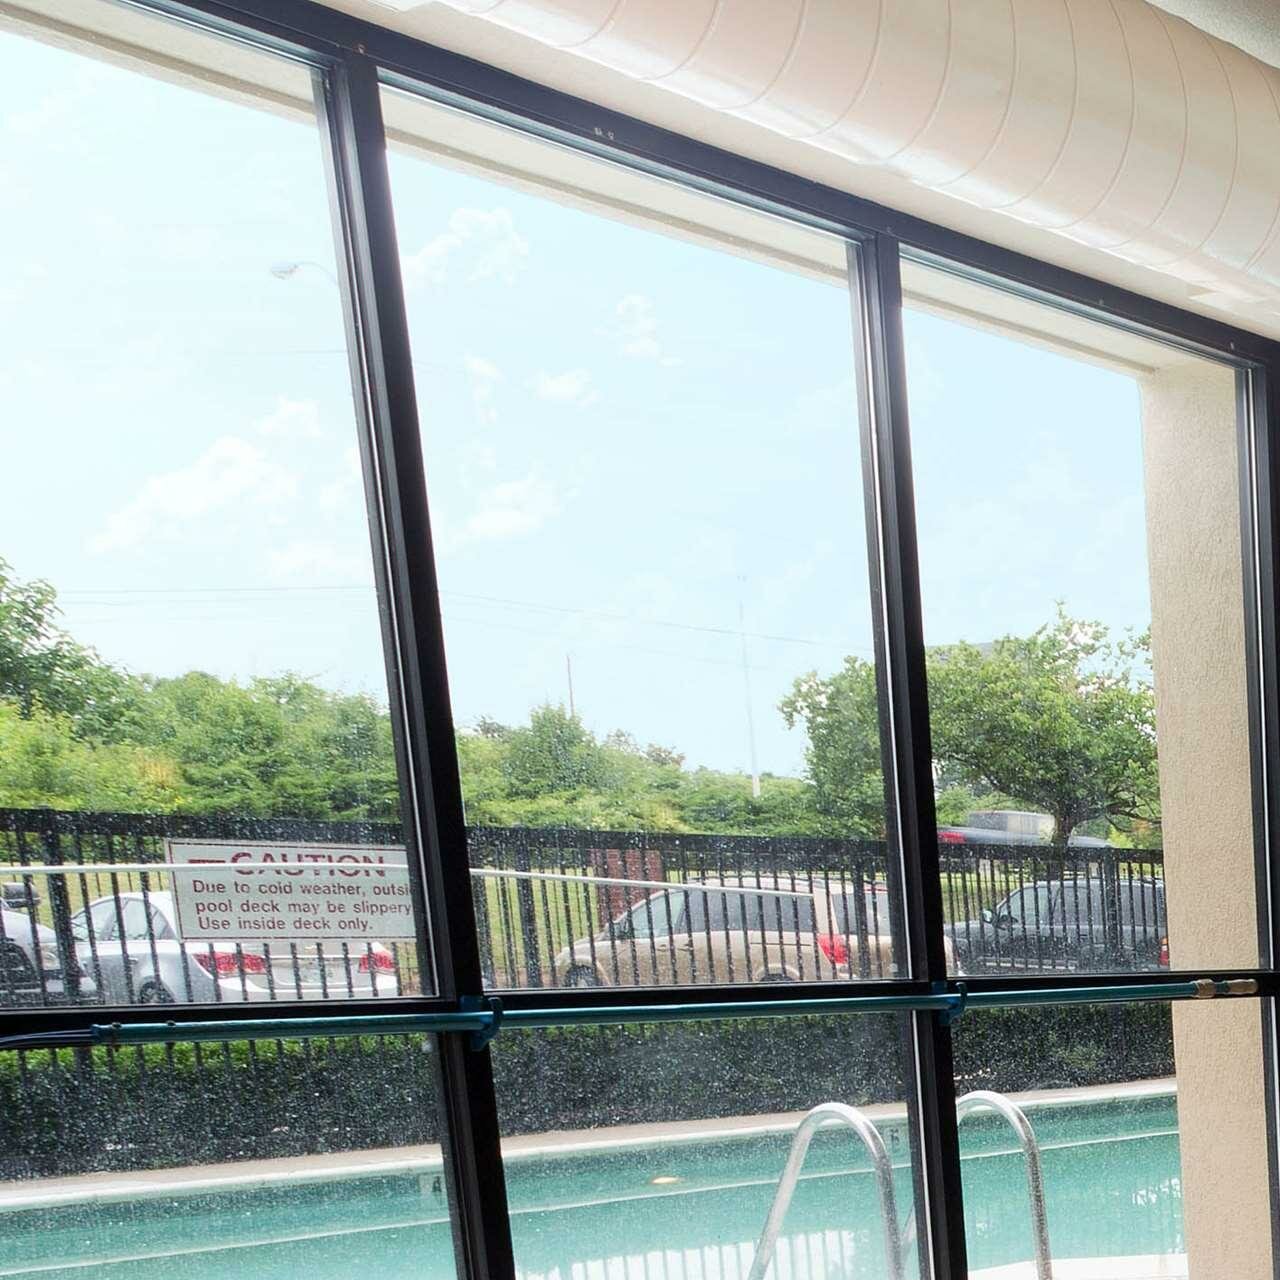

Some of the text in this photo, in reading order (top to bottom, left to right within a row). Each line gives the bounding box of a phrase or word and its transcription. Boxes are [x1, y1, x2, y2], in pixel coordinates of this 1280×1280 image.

[231, 852, 385, 877] CAUTION
[192, 880, 409, 897] Due to cold weather, outsi
[195, 900, 411, 916] pool deck may be slippery
[199, 916, 374, 932] Use inside deck only.
